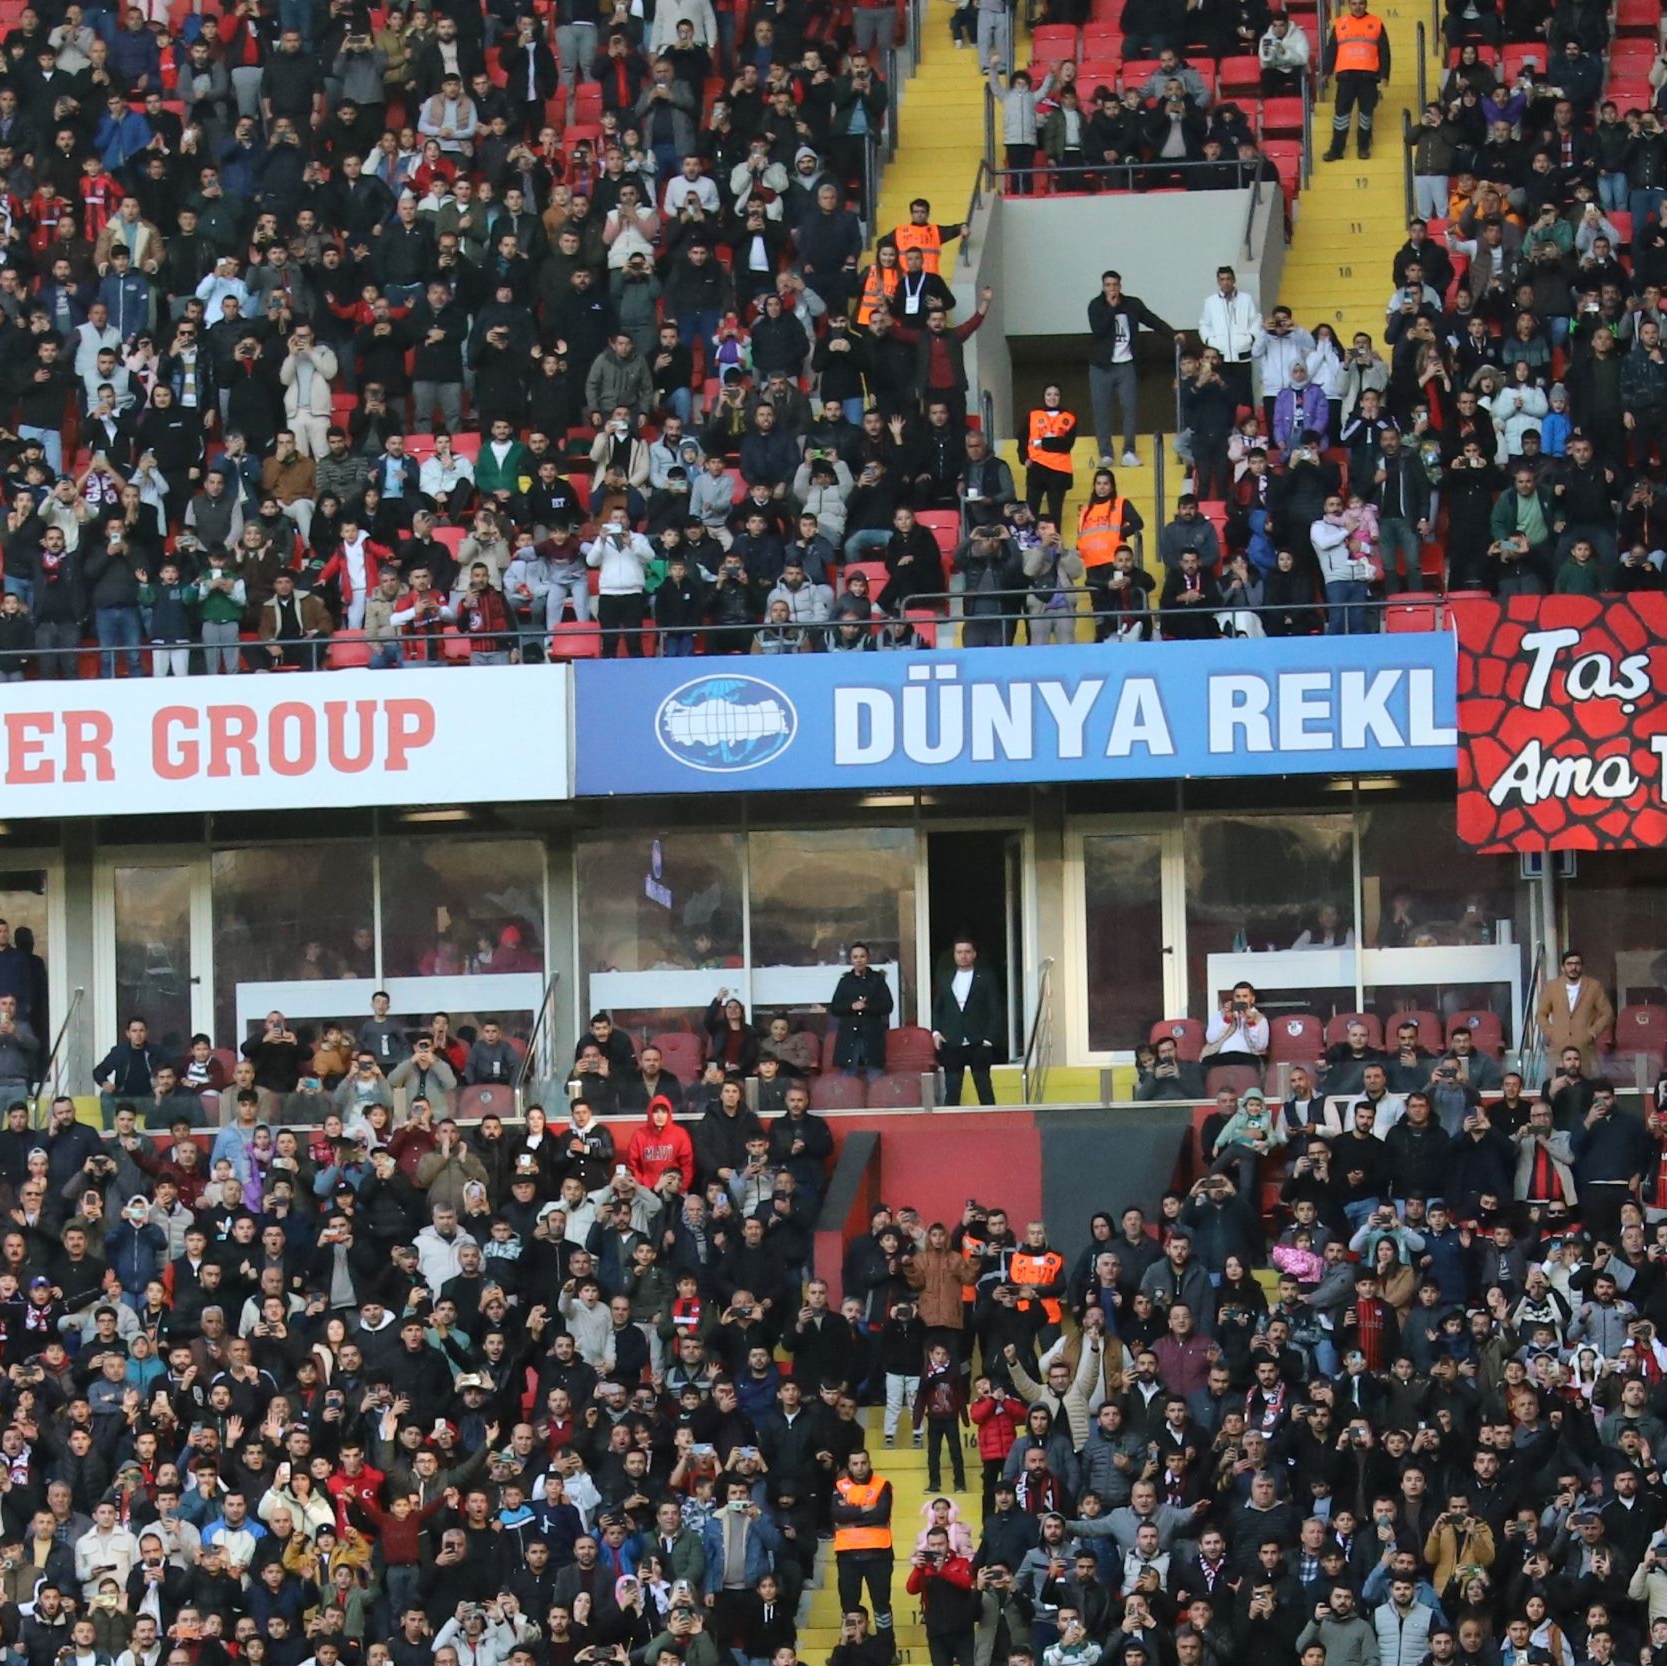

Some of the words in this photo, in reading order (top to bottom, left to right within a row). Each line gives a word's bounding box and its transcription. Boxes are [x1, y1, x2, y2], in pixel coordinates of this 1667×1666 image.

[1350, 223, 1363, 236] 11
[1520, 627, 1651, 717] Taş
[152, 698, 435, 781] GROUP
[832, 664, 1176, 766] DÜNYA
[1209, 667, 1459, 756] REKL
[1489, 738, 1639, 808] Ama
[962, 1433, 978, 1449] 16
